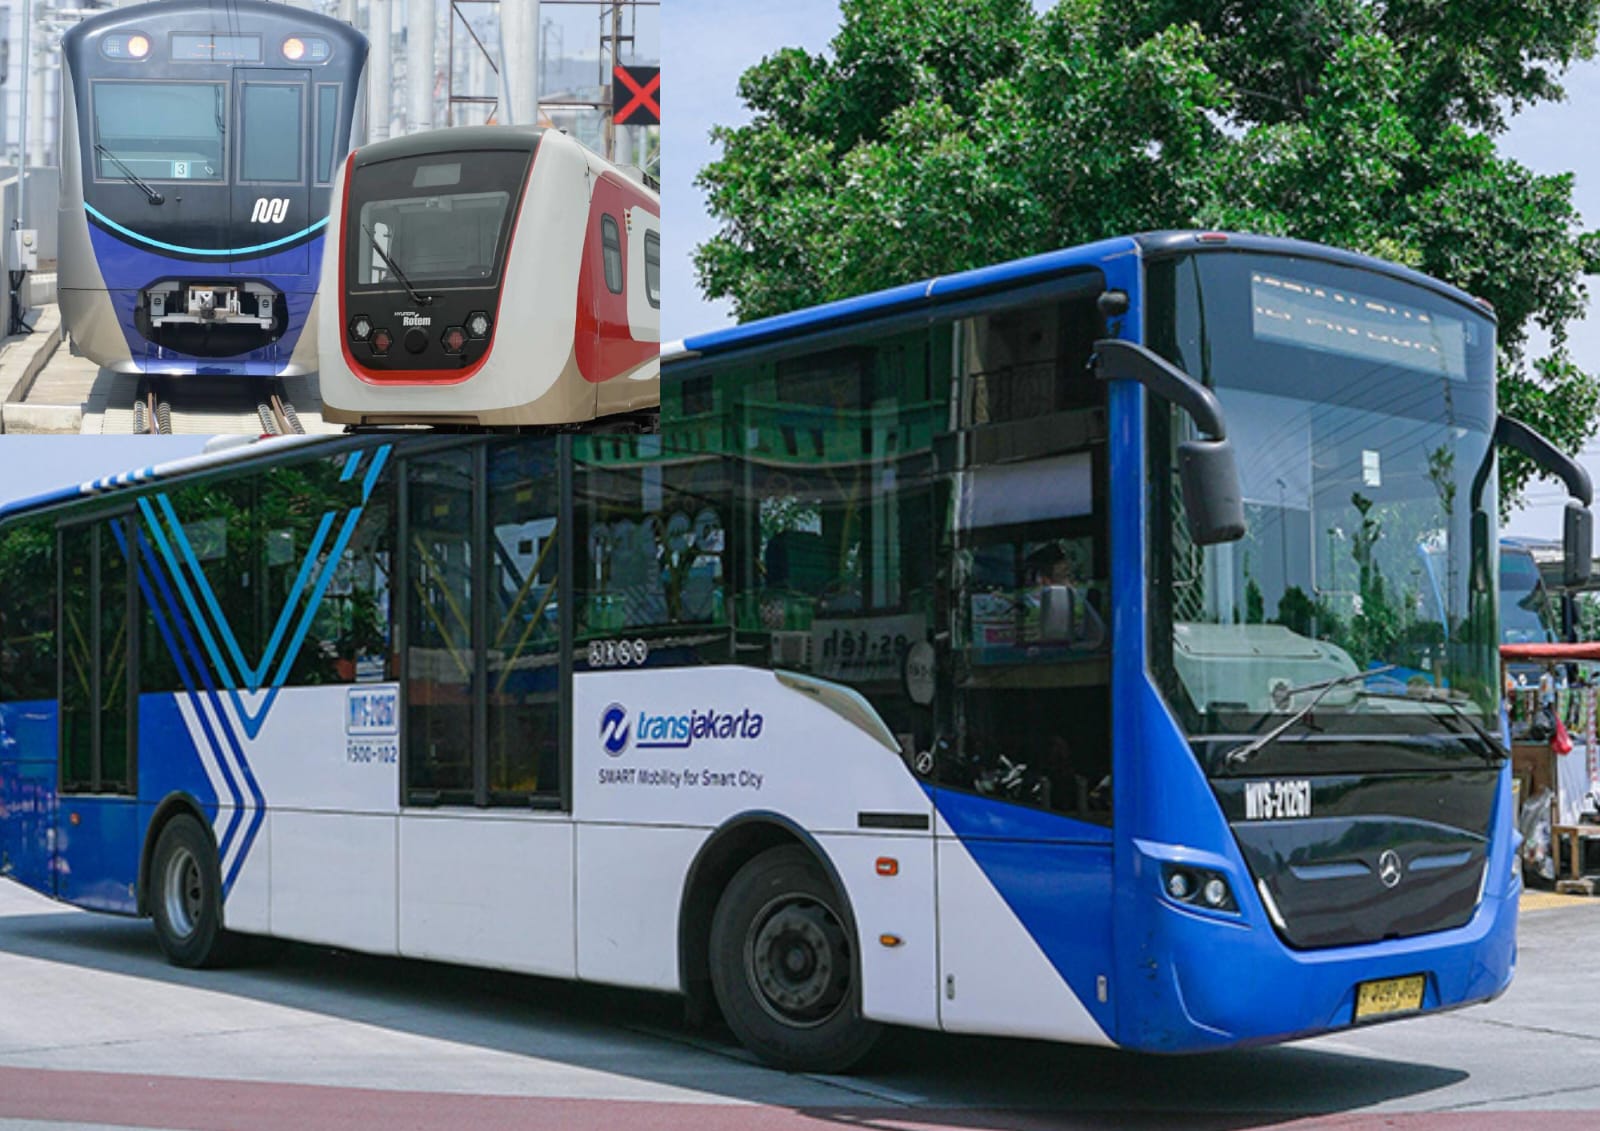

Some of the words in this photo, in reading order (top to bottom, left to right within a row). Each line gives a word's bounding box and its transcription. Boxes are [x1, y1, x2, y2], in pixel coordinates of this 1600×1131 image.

[178, 163, 185, 175] 3
[403, 313, 431, 326] Rotem
[636, 708, 764, 748] transjakarta
[599, 768, 635, 785] SMART
[638, 768, 681, 789] Mobility
[684, 768, 698, 786] for
[702, 769, 736, 787] Smart
[738, 770, 764, 790] City
